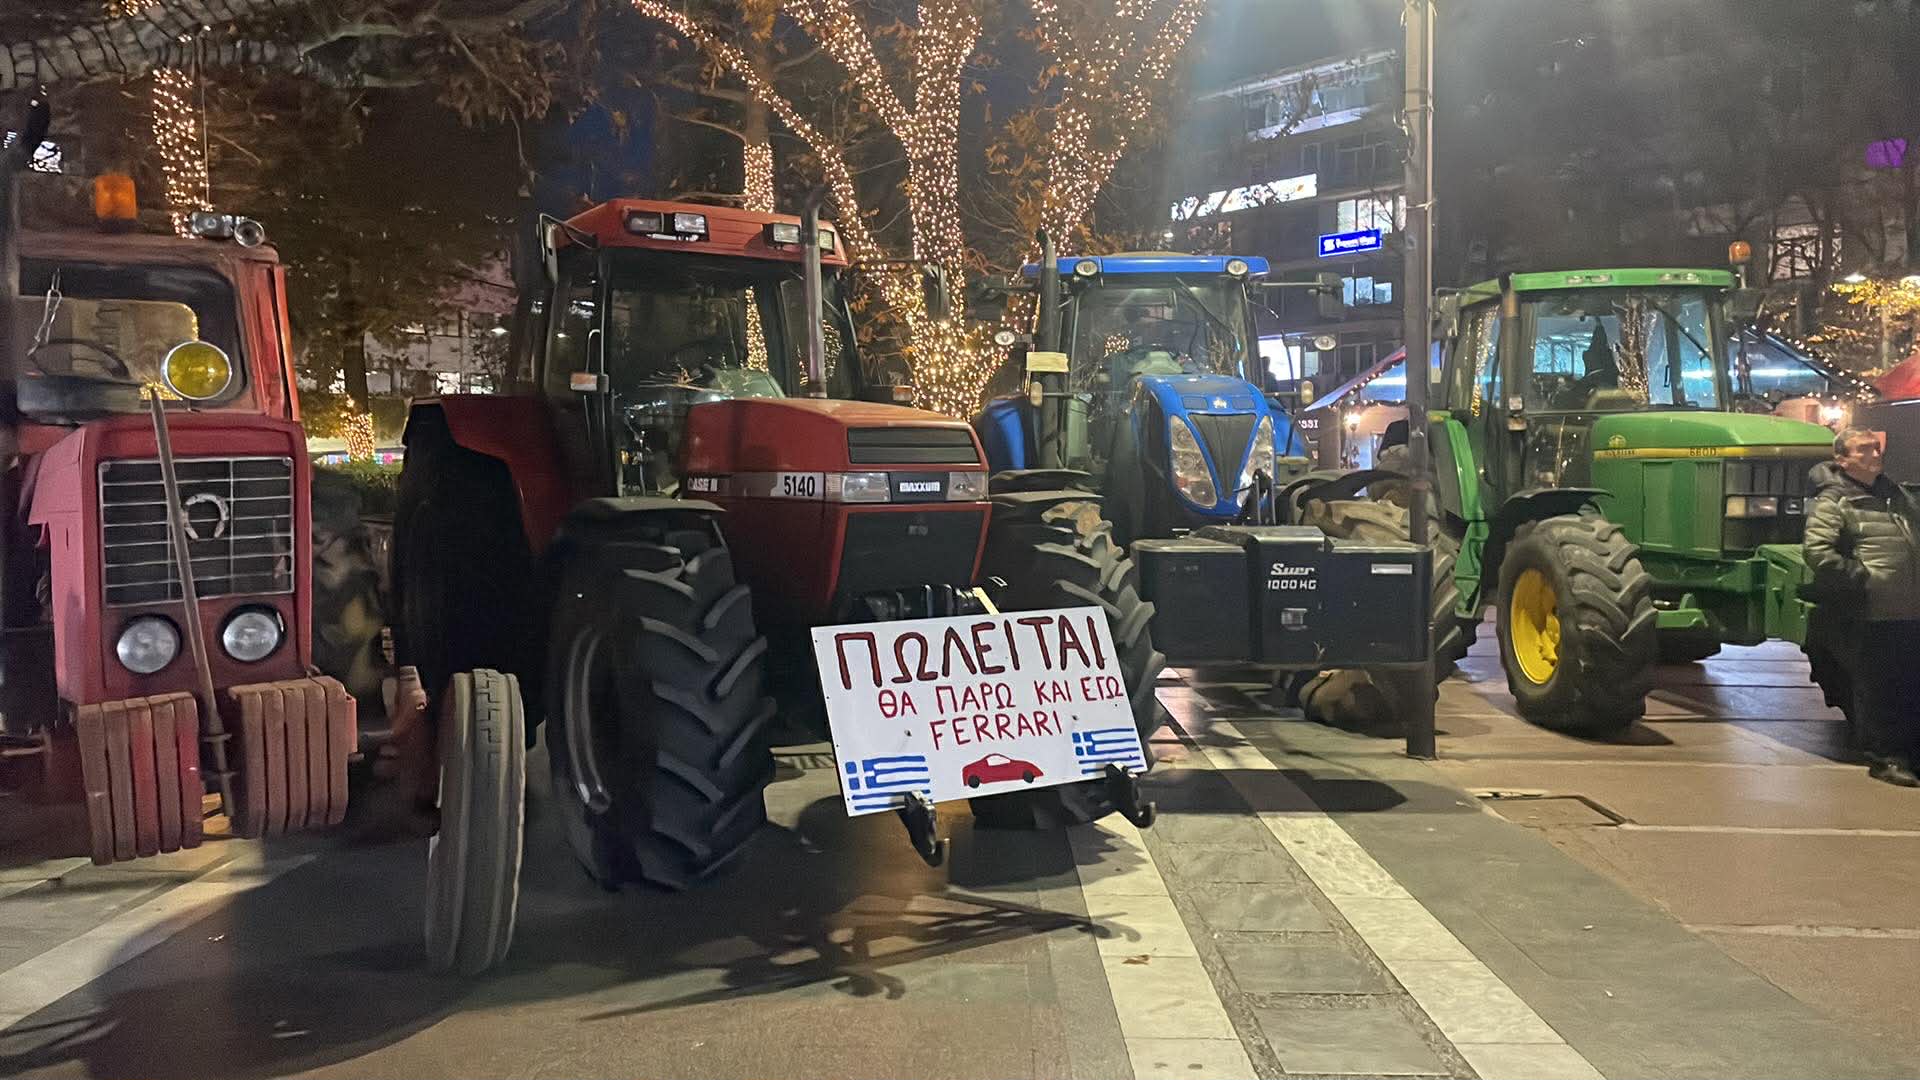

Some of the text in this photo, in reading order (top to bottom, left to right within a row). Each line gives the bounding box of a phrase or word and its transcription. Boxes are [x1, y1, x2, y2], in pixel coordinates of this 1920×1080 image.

[783, 475, 816, 497] 5140
[899, 481, 941, 492] MAXXUM
[1270, 563, 1315, 576] Suer
[1267, 579, 1317, 590] 1000 KG
[834, 614, 1105, 690] ΠΩΛΕΙΤΑΙ
[878, 675, 1124, 718] ΘΑ ΠΑΡΩ ΚΑΙ ΕΓΩ
[929, 711, 1063, 750] FERRARI
